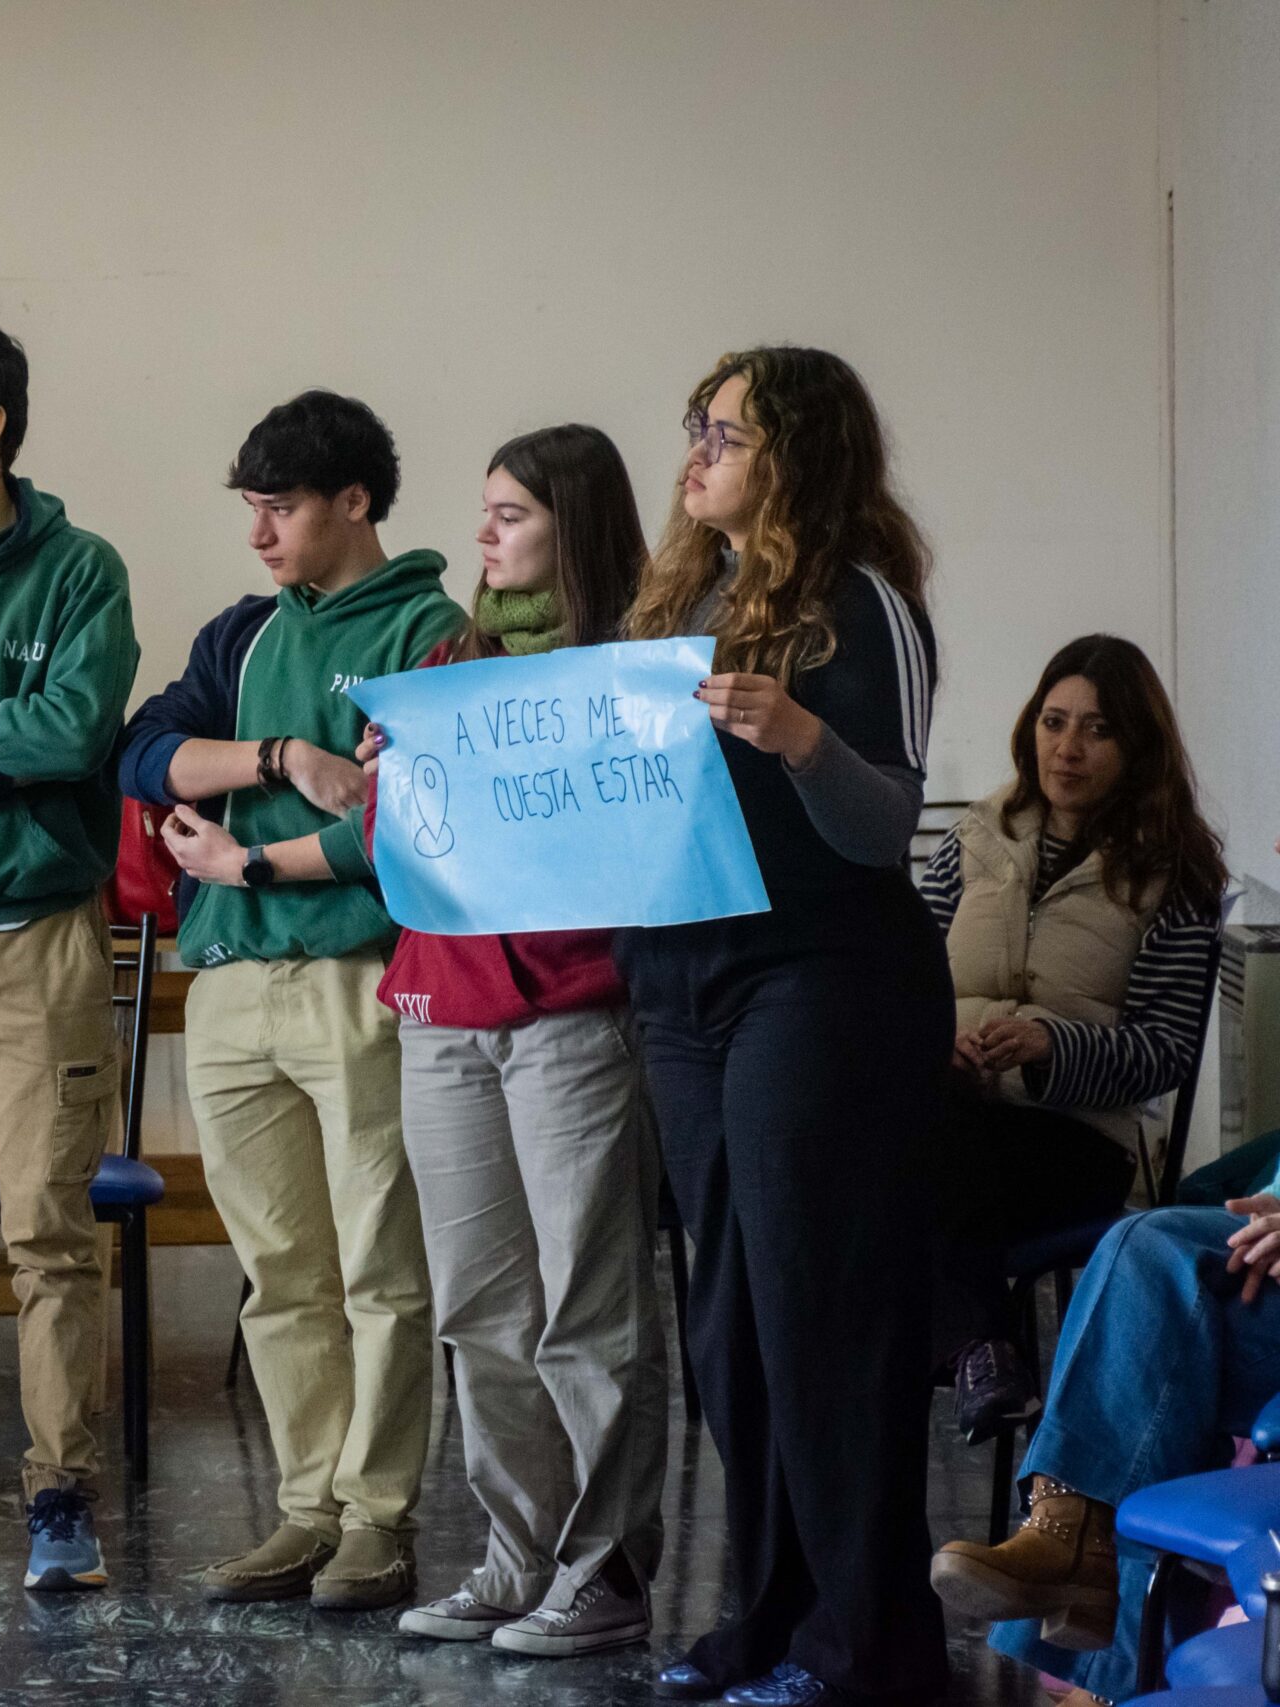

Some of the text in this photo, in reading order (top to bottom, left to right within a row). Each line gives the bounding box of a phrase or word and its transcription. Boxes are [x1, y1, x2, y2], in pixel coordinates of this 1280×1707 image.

[3, 639, 46, 661] NAU
[457, 694, 626, 755] A VECES ME
[493, 754, 683, 821] CUESTA ESTAR
